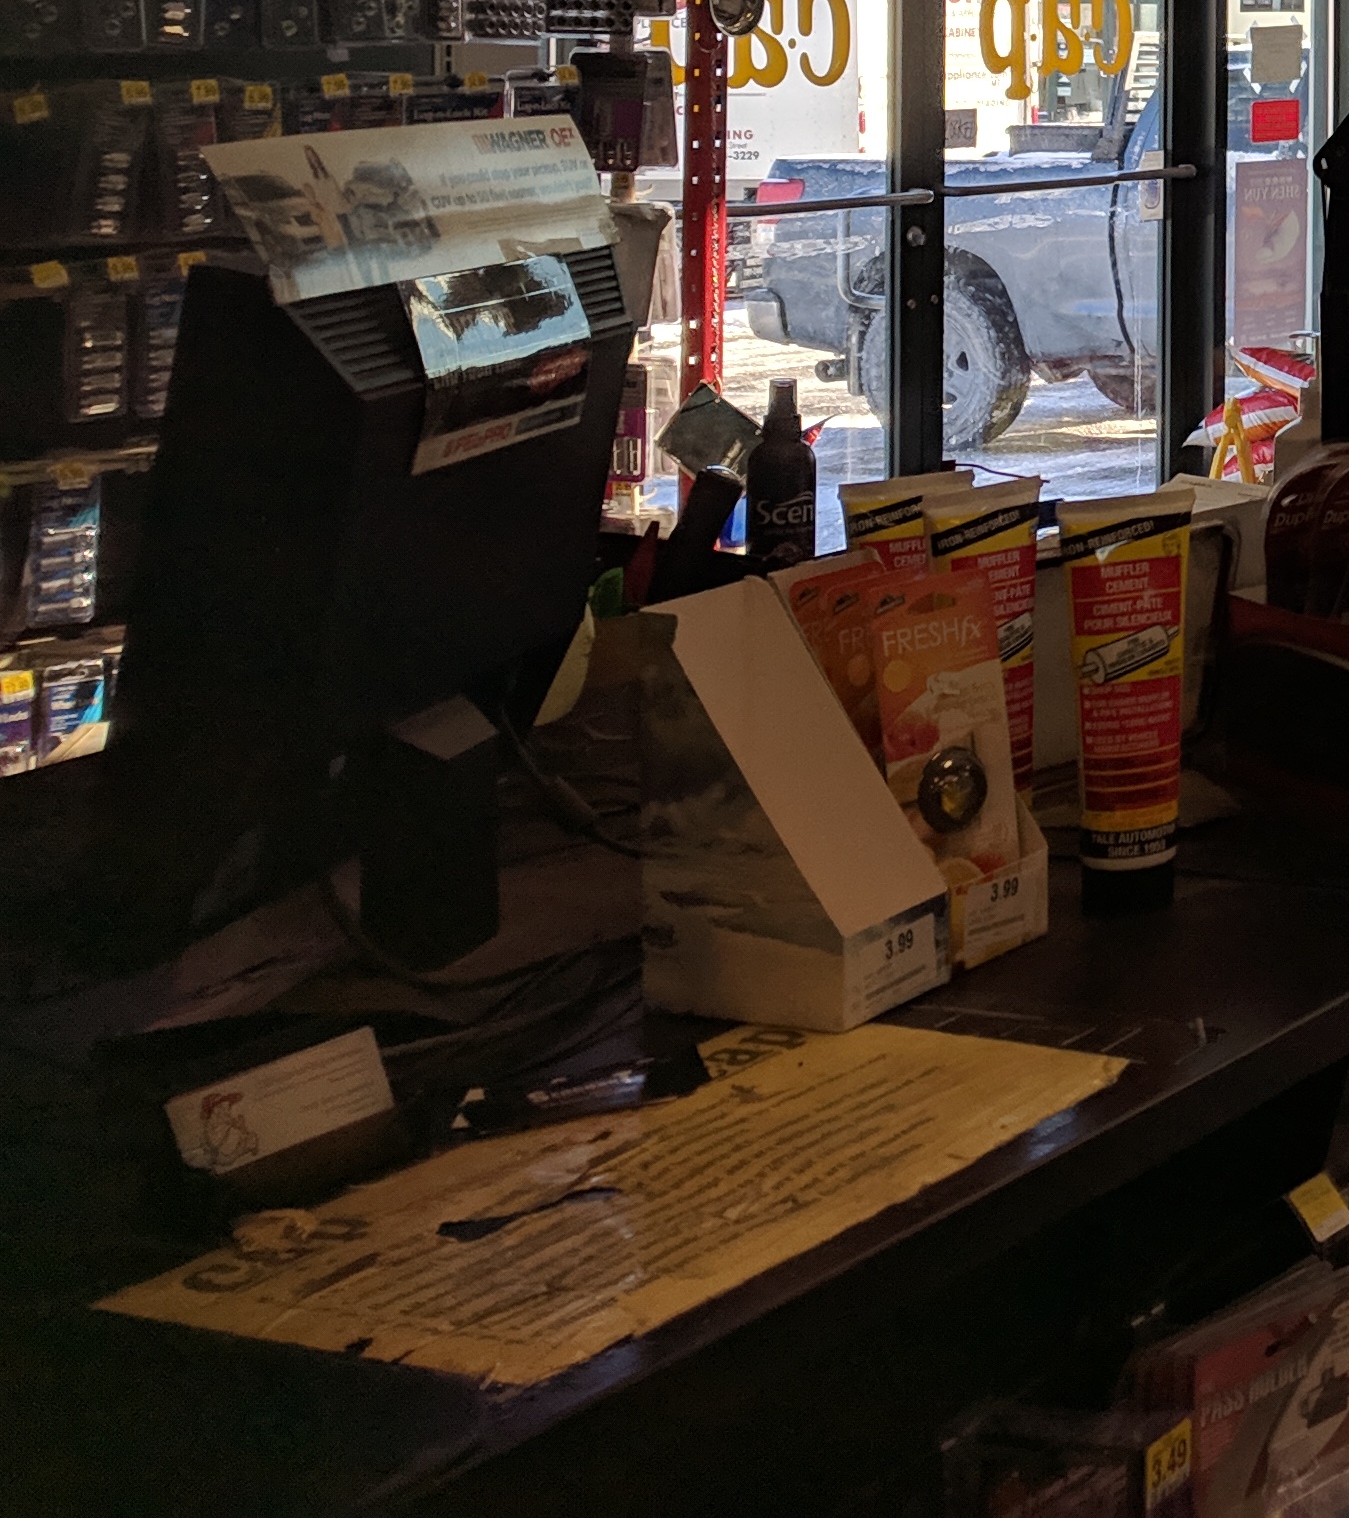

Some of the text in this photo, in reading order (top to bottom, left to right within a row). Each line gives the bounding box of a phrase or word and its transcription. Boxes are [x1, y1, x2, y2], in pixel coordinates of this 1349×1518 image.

[488, 128, 549, 154] WAGNER
[977, 550, 1021, 570] MUFFLER
[1100, 561, 1149, 578] MUFFLER
[988, 565, 1020, 581] EMENT
[1105, 576, 1149, 594] CEMENT
[1083, 616, 1115, 631] POUR
[990, 877, 1020, 903] 3.99
[884, 929, 914, 961] 3.99
[1150, 1438, 1188, 1489] 3.49
